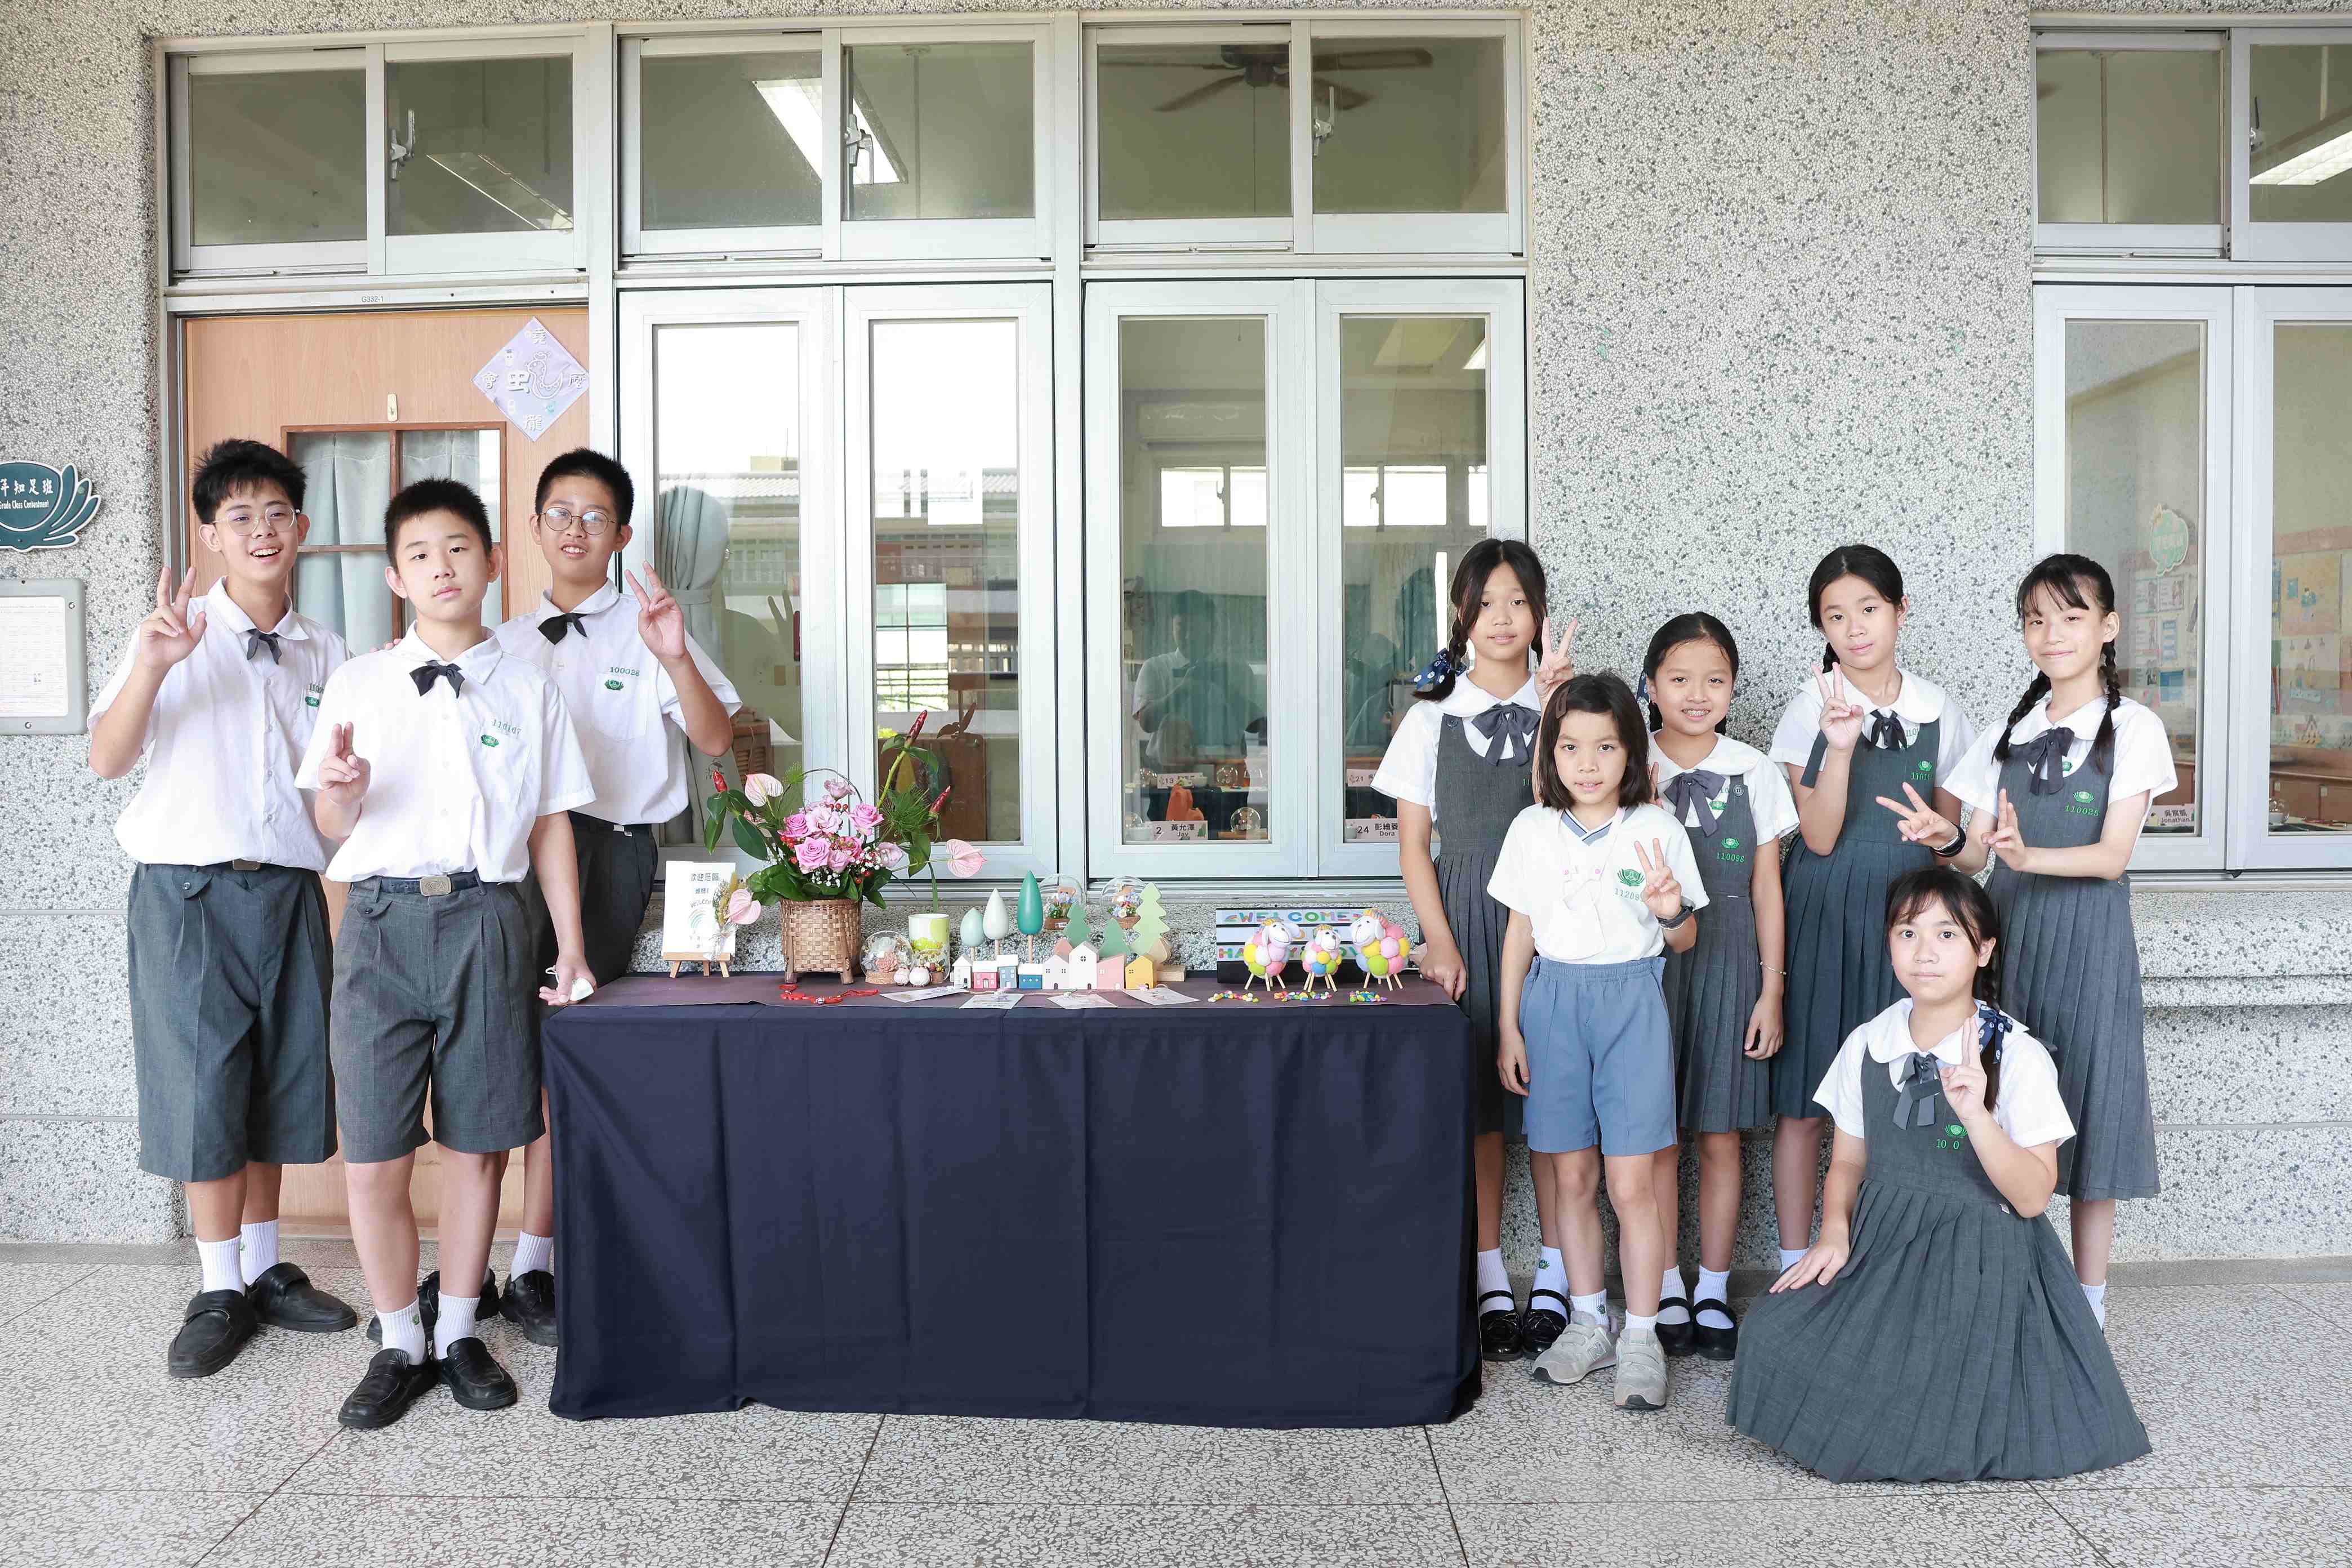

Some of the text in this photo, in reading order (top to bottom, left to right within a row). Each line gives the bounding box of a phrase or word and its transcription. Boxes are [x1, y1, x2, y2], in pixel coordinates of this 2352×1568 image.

[12, 500, 23, 509] Class
[24, 500, 49, 509] Contentment
[609, 667, 640, 676] 100028
[1716, 852, 1744, 863] 110098
